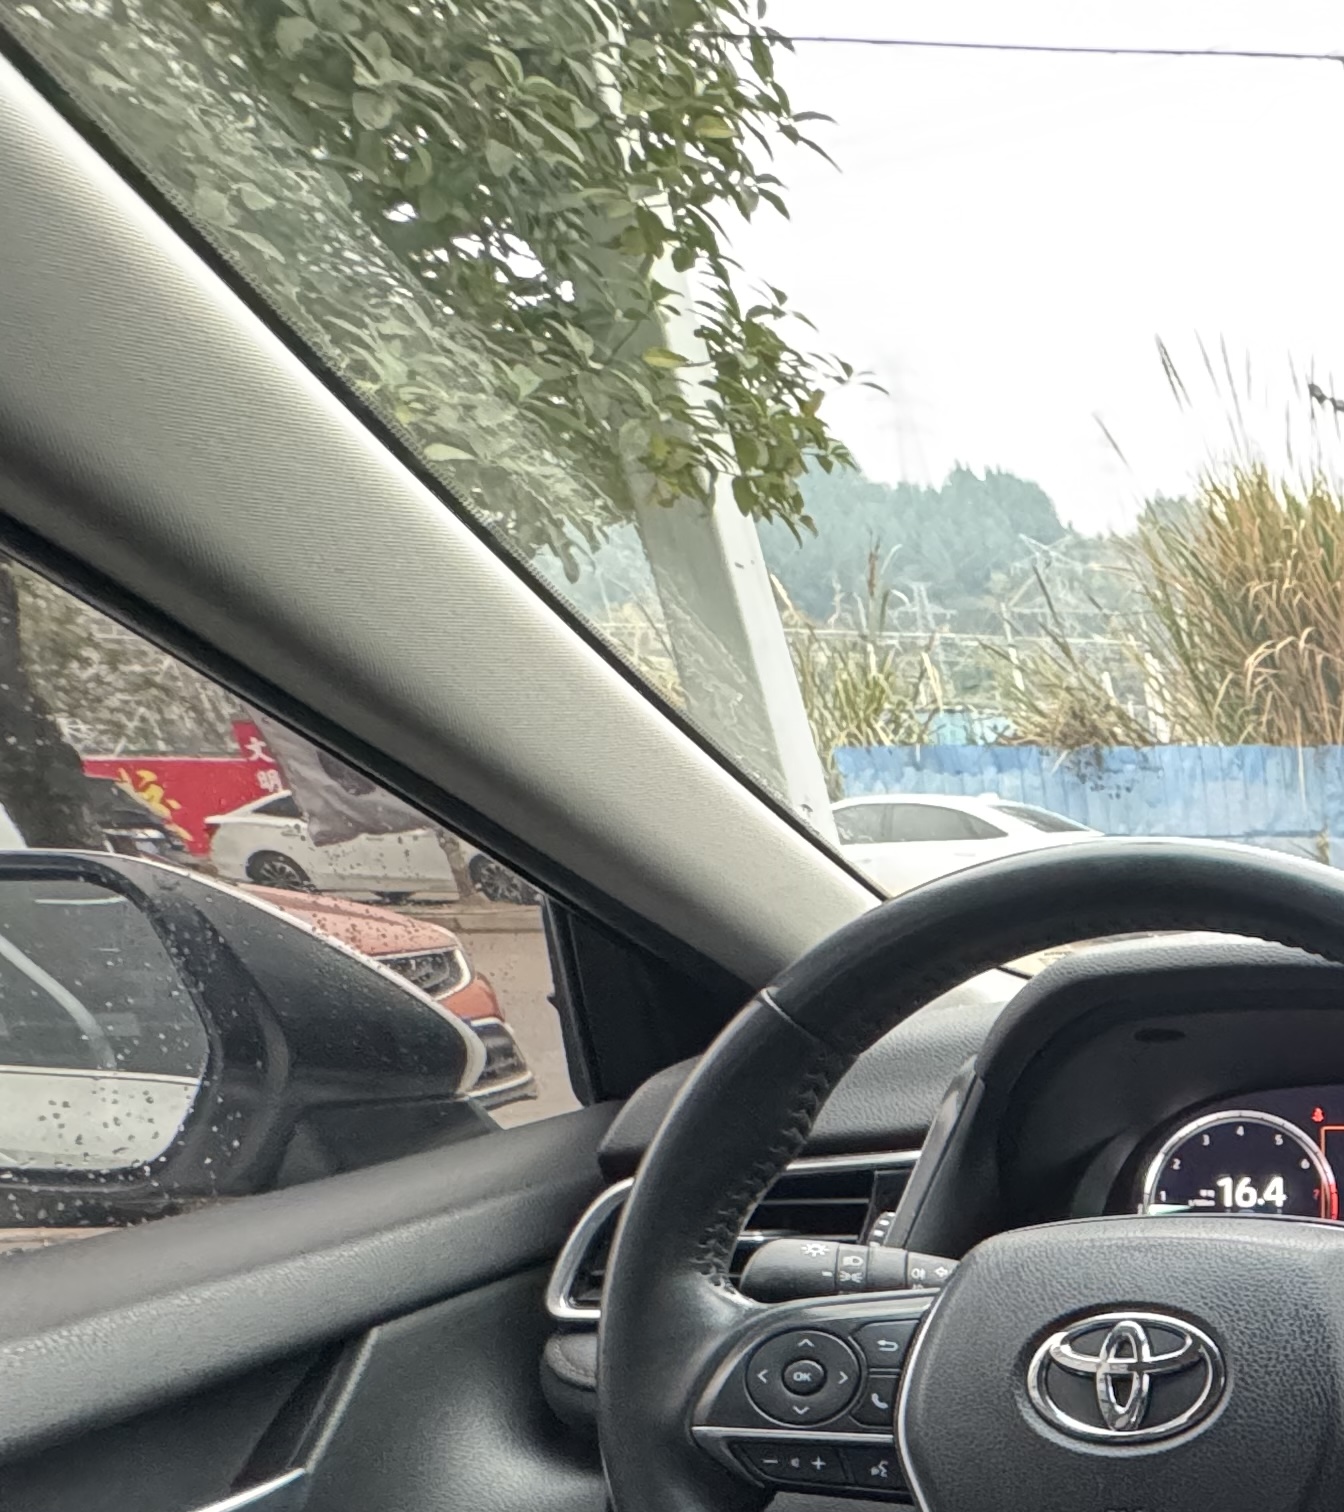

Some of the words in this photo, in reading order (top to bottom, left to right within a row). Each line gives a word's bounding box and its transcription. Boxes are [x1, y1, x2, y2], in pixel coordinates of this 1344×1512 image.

[243, 736, 284, 793] 文明
[1217, 1176, 1288, 1208] 16.4
[793, 1371, 812, 1382] OK
